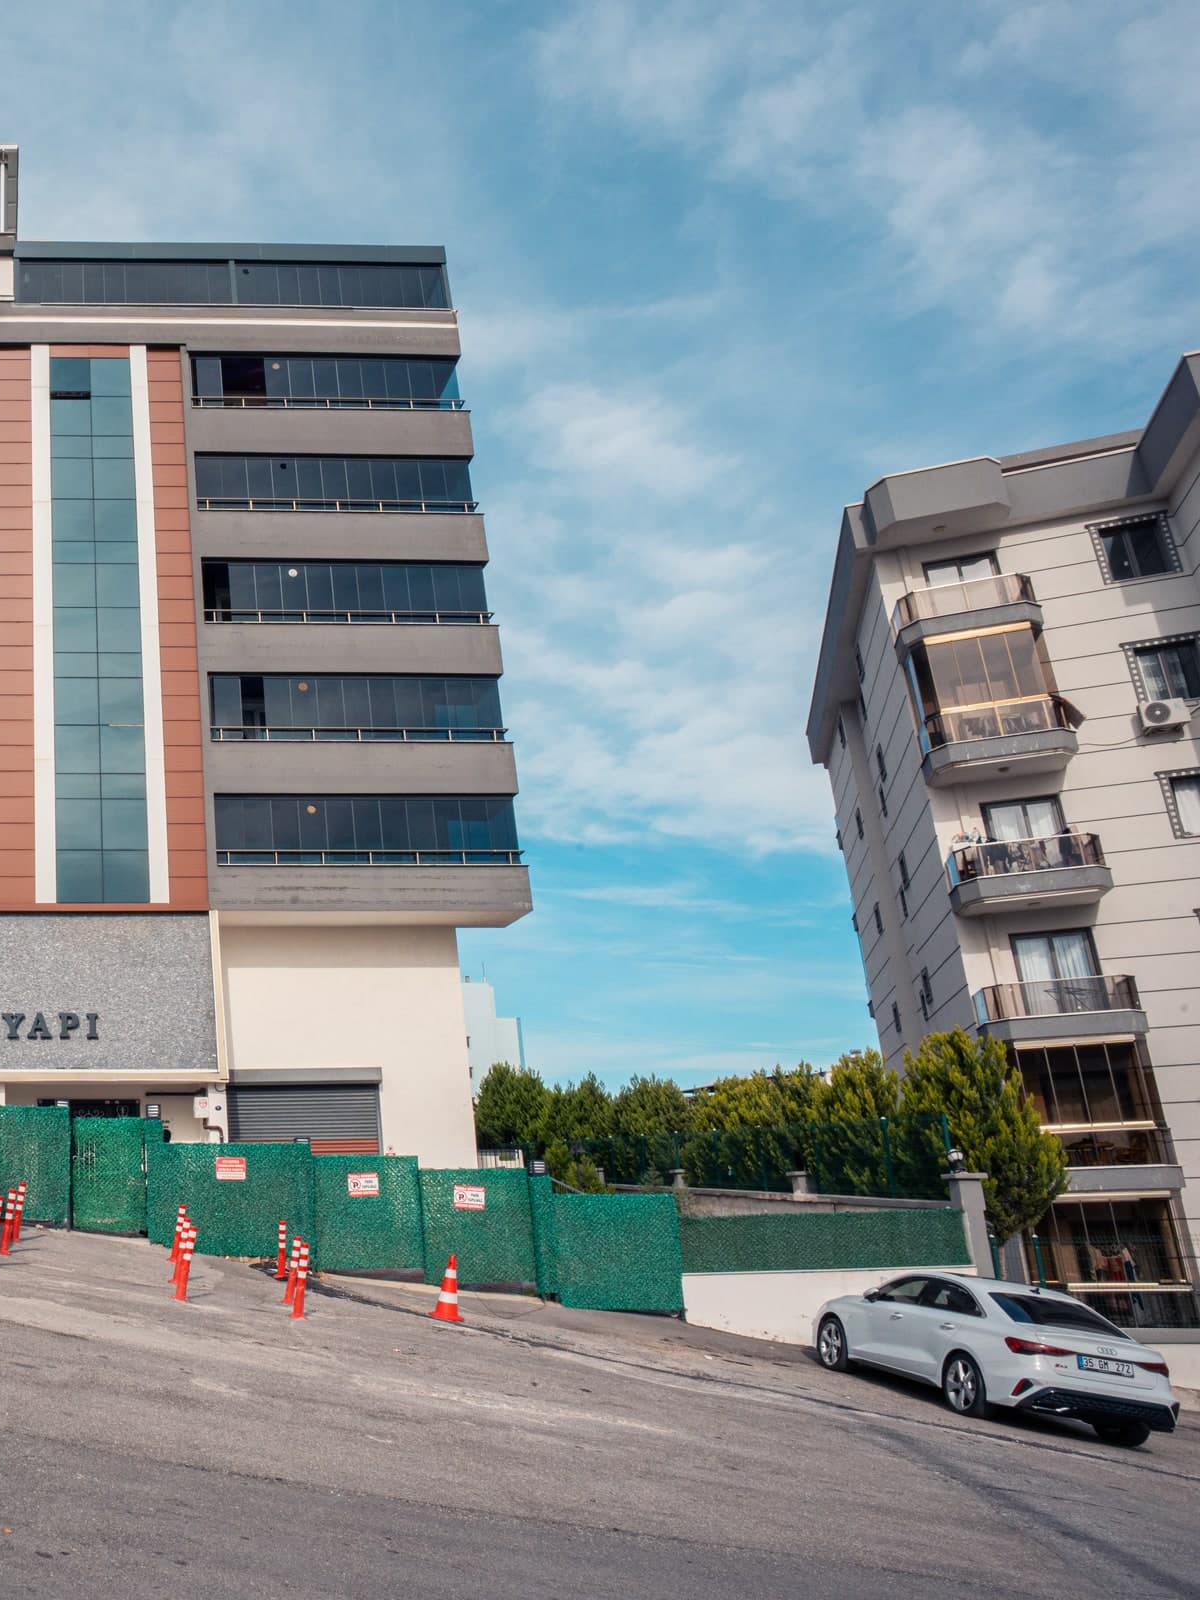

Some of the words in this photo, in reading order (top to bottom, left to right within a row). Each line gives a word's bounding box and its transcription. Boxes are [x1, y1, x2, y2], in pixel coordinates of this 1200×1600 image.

[2, 1012, 99, 1040] YAPI
[1083, 1357, 1094, 1367] 35
[1098, 1360, 1109, 1370] GM
[1115, 1362, 1131, 1374] 272
